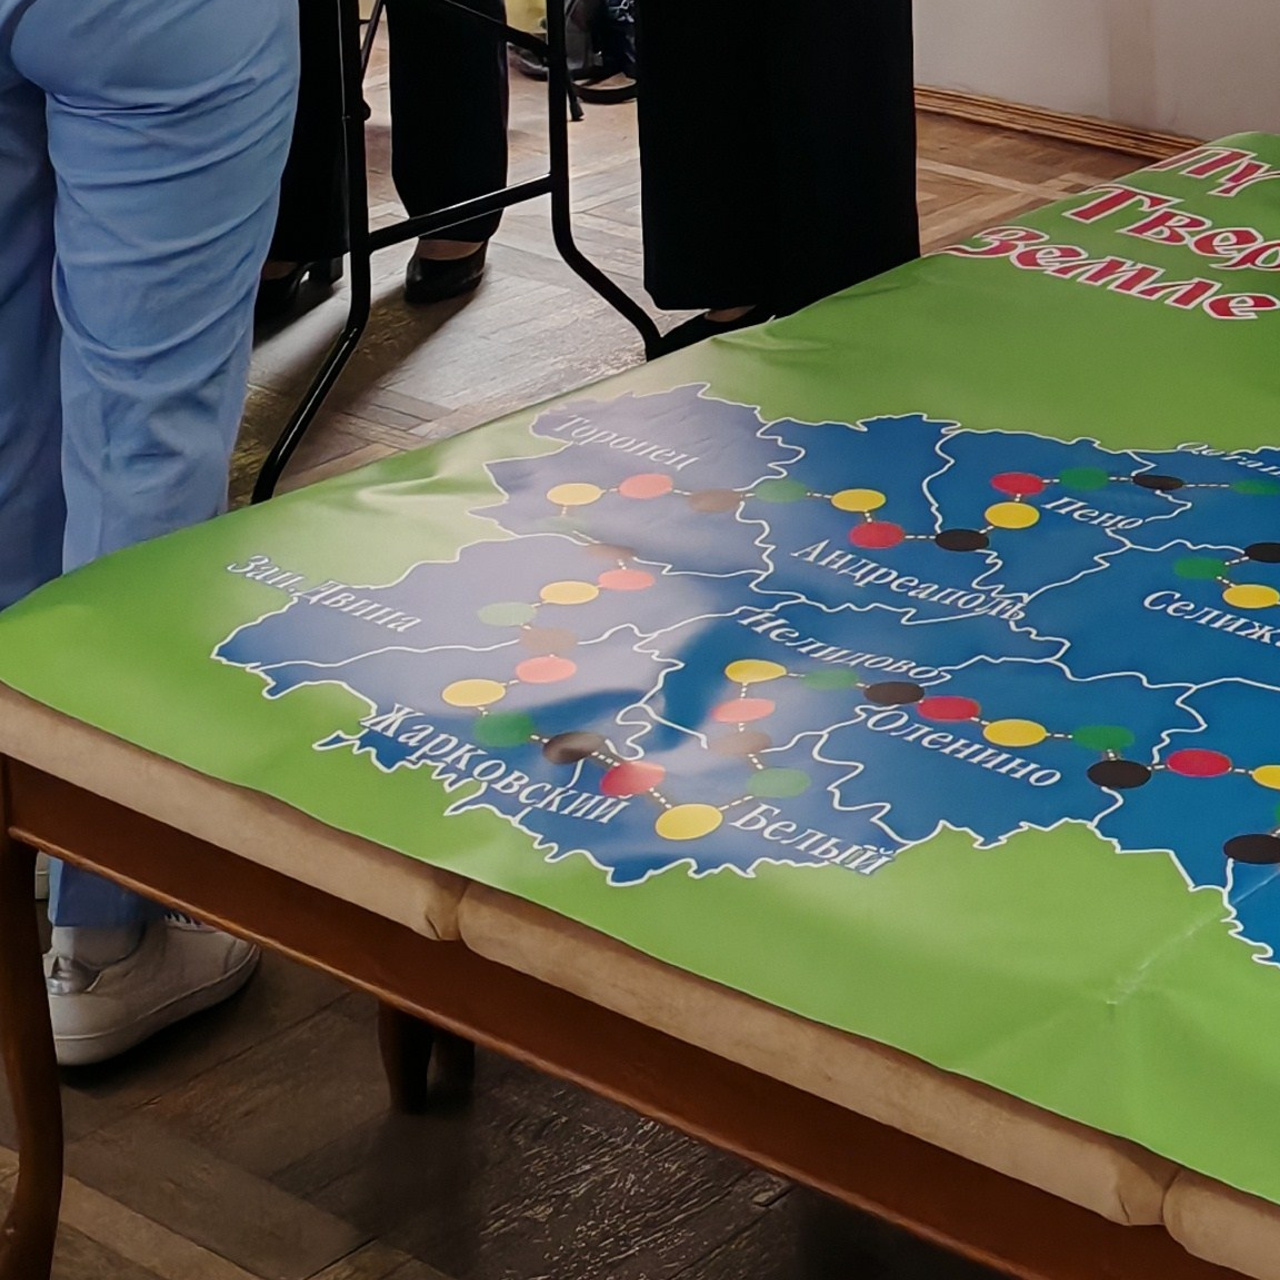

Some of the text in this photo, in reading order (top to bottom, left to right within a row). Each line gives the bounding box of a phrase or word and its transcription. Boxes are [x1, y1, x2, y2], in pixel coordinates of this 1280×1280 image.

[553, 414, 700, 471] Торопец
[1040, 496, 1147, 530] Пено
[790, 539, 1028, 621] Андреаполь
[738, 610, 942, 681] Нелидово
[362, 703, 632, 824] Жарковский
[866, 710, 1062, 788] Оленино
[730, 803, 896, 875] Белый
